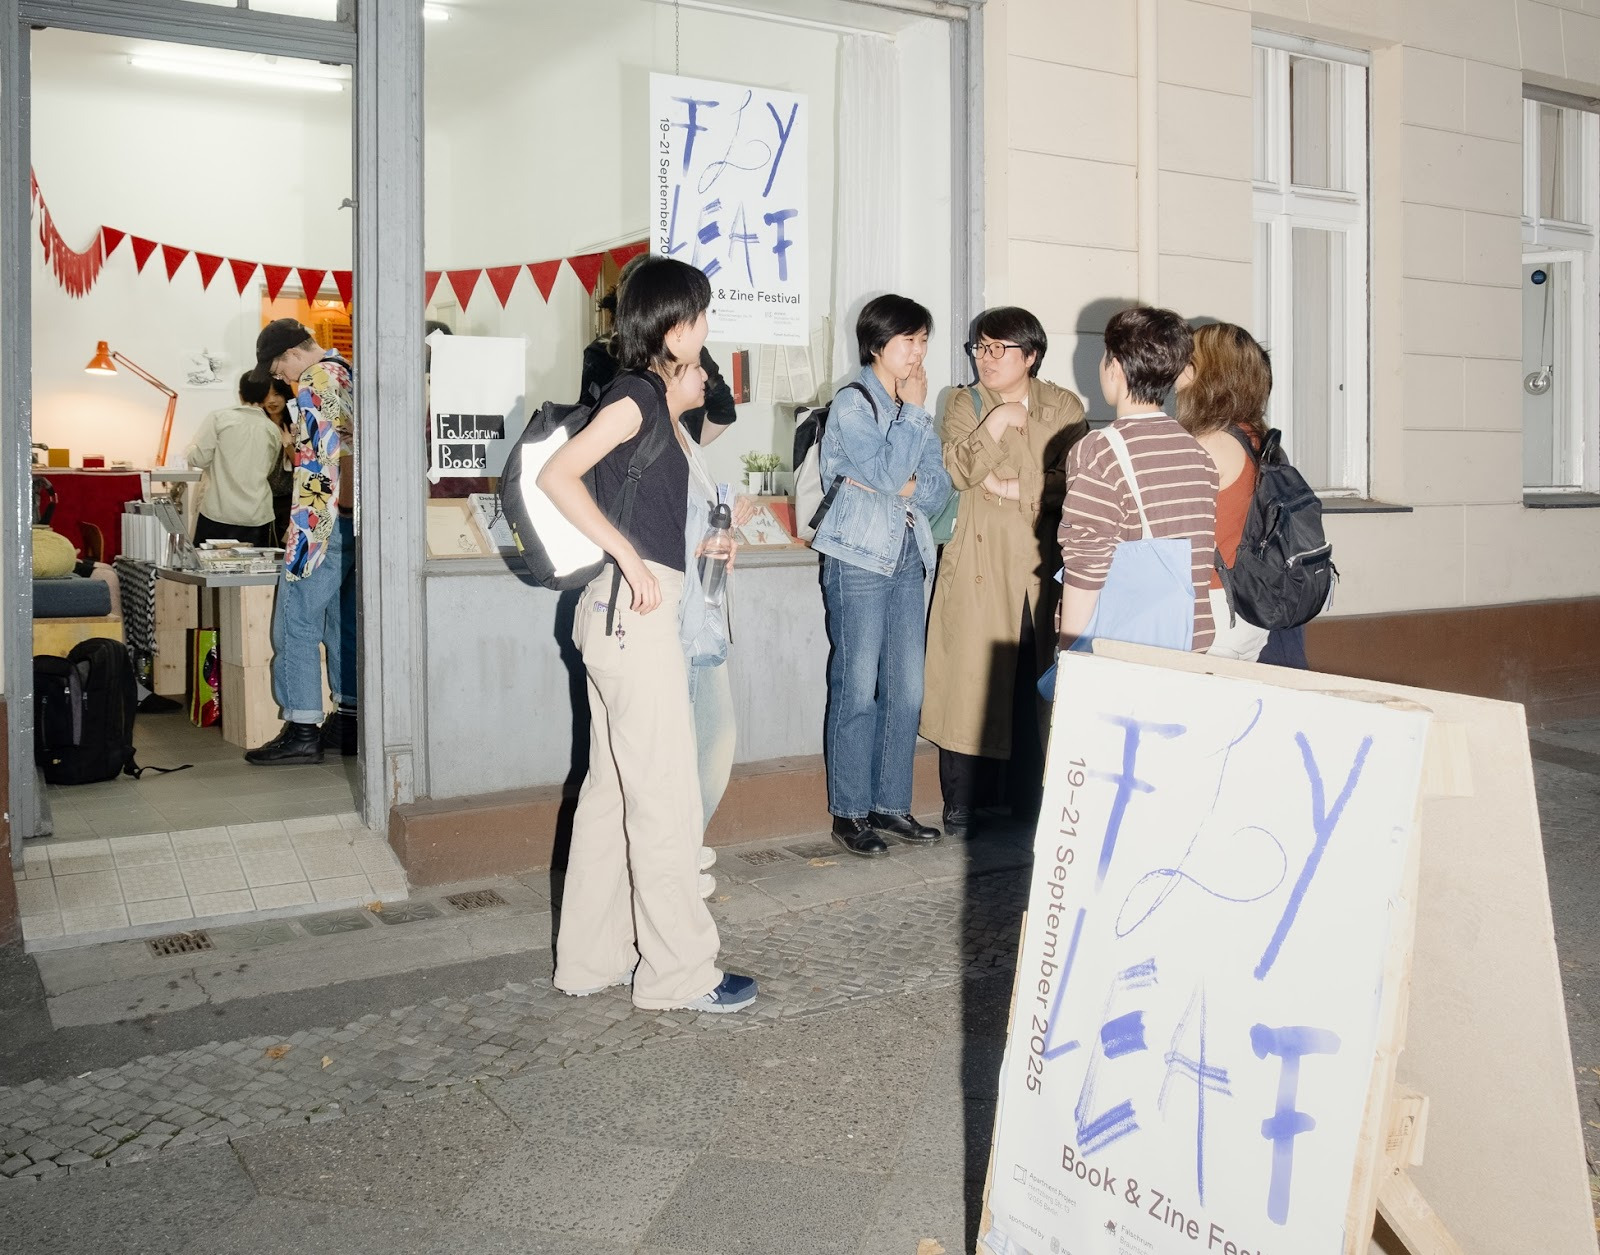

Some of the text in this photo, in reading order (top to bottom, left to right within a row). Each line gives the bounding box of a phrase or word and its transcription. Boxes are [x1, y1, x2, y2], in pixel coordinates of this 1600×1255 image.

[671, 89, 799, 197] FLY
[658, 158, 670, 235] September
[717, 288, 726, 300] &
[729, 289, 754, 302] Zine
[757, 291, 801, 304] Festival
[439, 413, 500, 440] Falschrum
[441, 444, 486, 469] Books
[1088, 699, 1373, 981] FLY
[1035, 845, 1076, 1011] September
[1026, 1019, 1050, 1096] 2025
[1008, 1213, 1038, 1235] sponsored
[1061, 1144, 1116, 1197] Book
[1124, 1178, 1142, 1208] &
[1147, 1188, 1200, 1241] Zine
[1121, 1224, 1154, 1251] Falschrum
